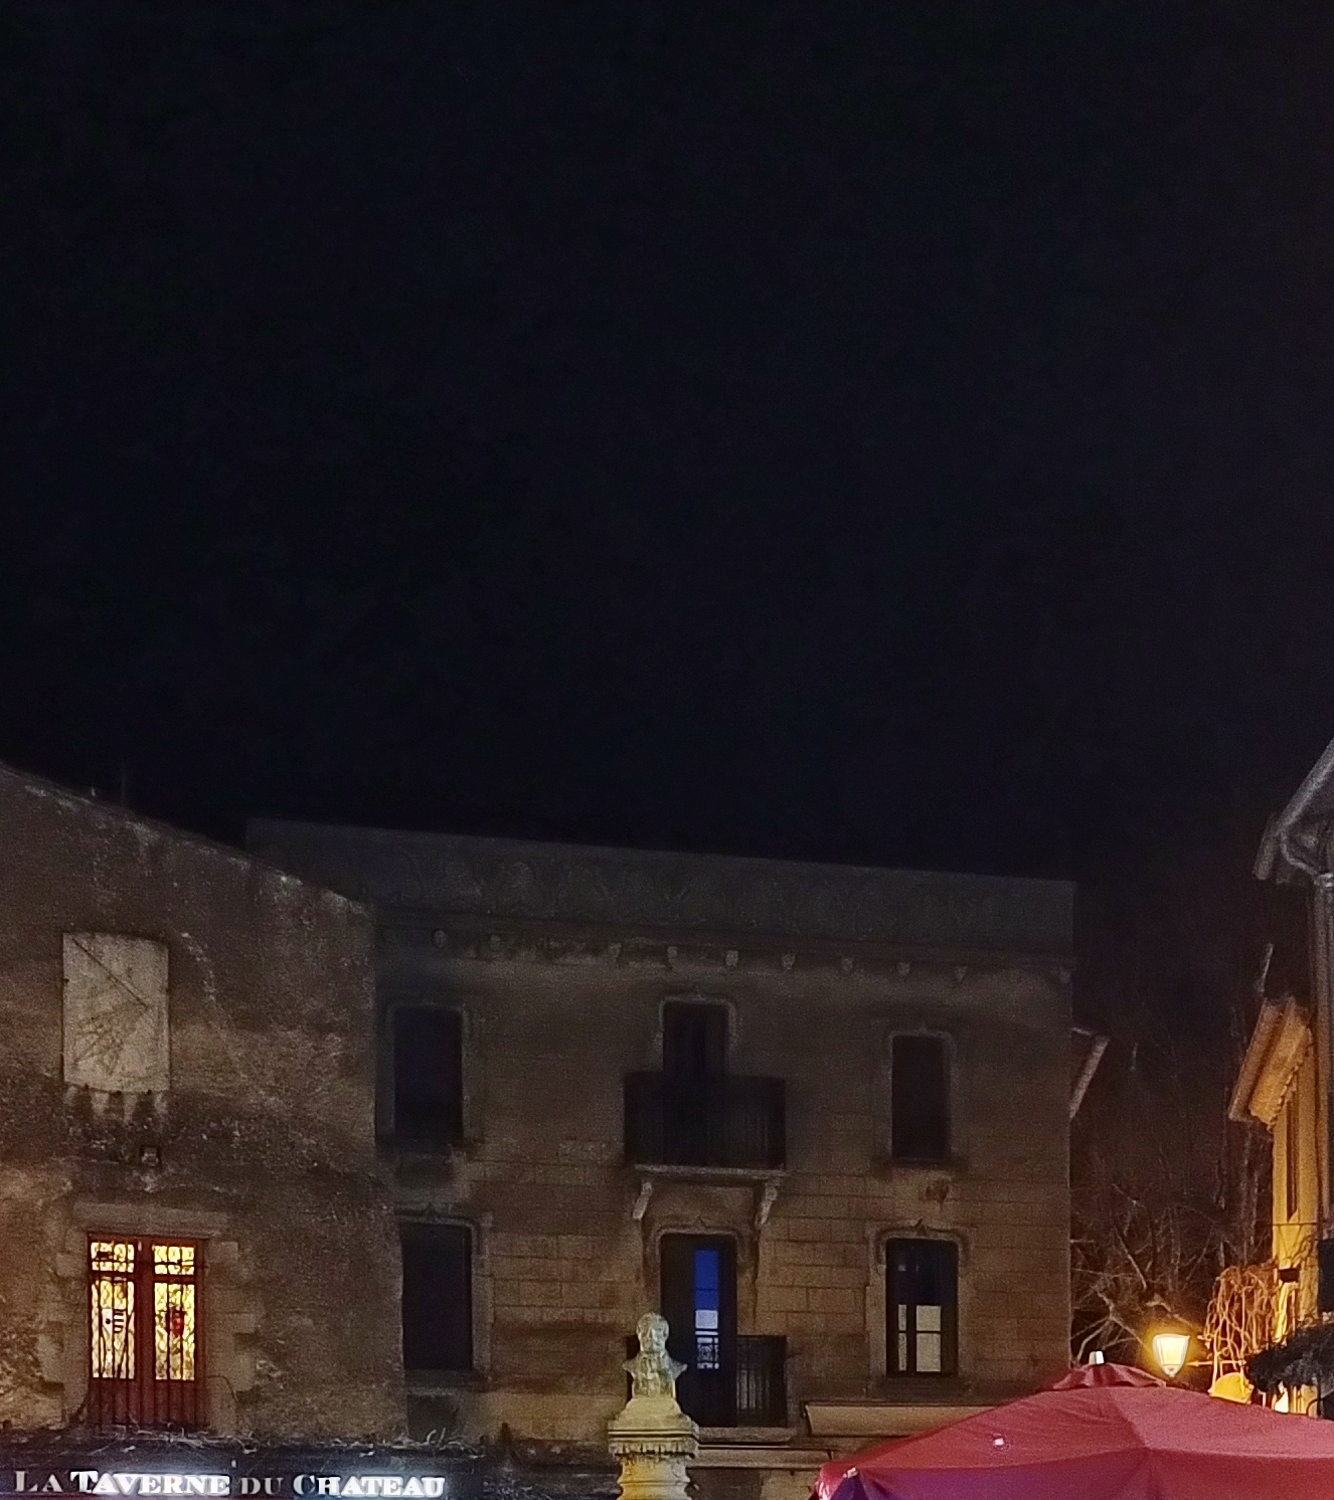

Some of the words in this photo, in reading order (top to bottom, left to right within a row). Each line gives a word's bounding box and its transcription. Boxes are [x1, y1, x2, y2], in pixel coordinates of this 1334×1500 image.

[15, 1470, 63, 1492] LA
[69, 1470, 230, 1495] TAVERNE
[240, 1477, 284, 1495] DU
[293, 1474, 446, 1498] CHATEAU
